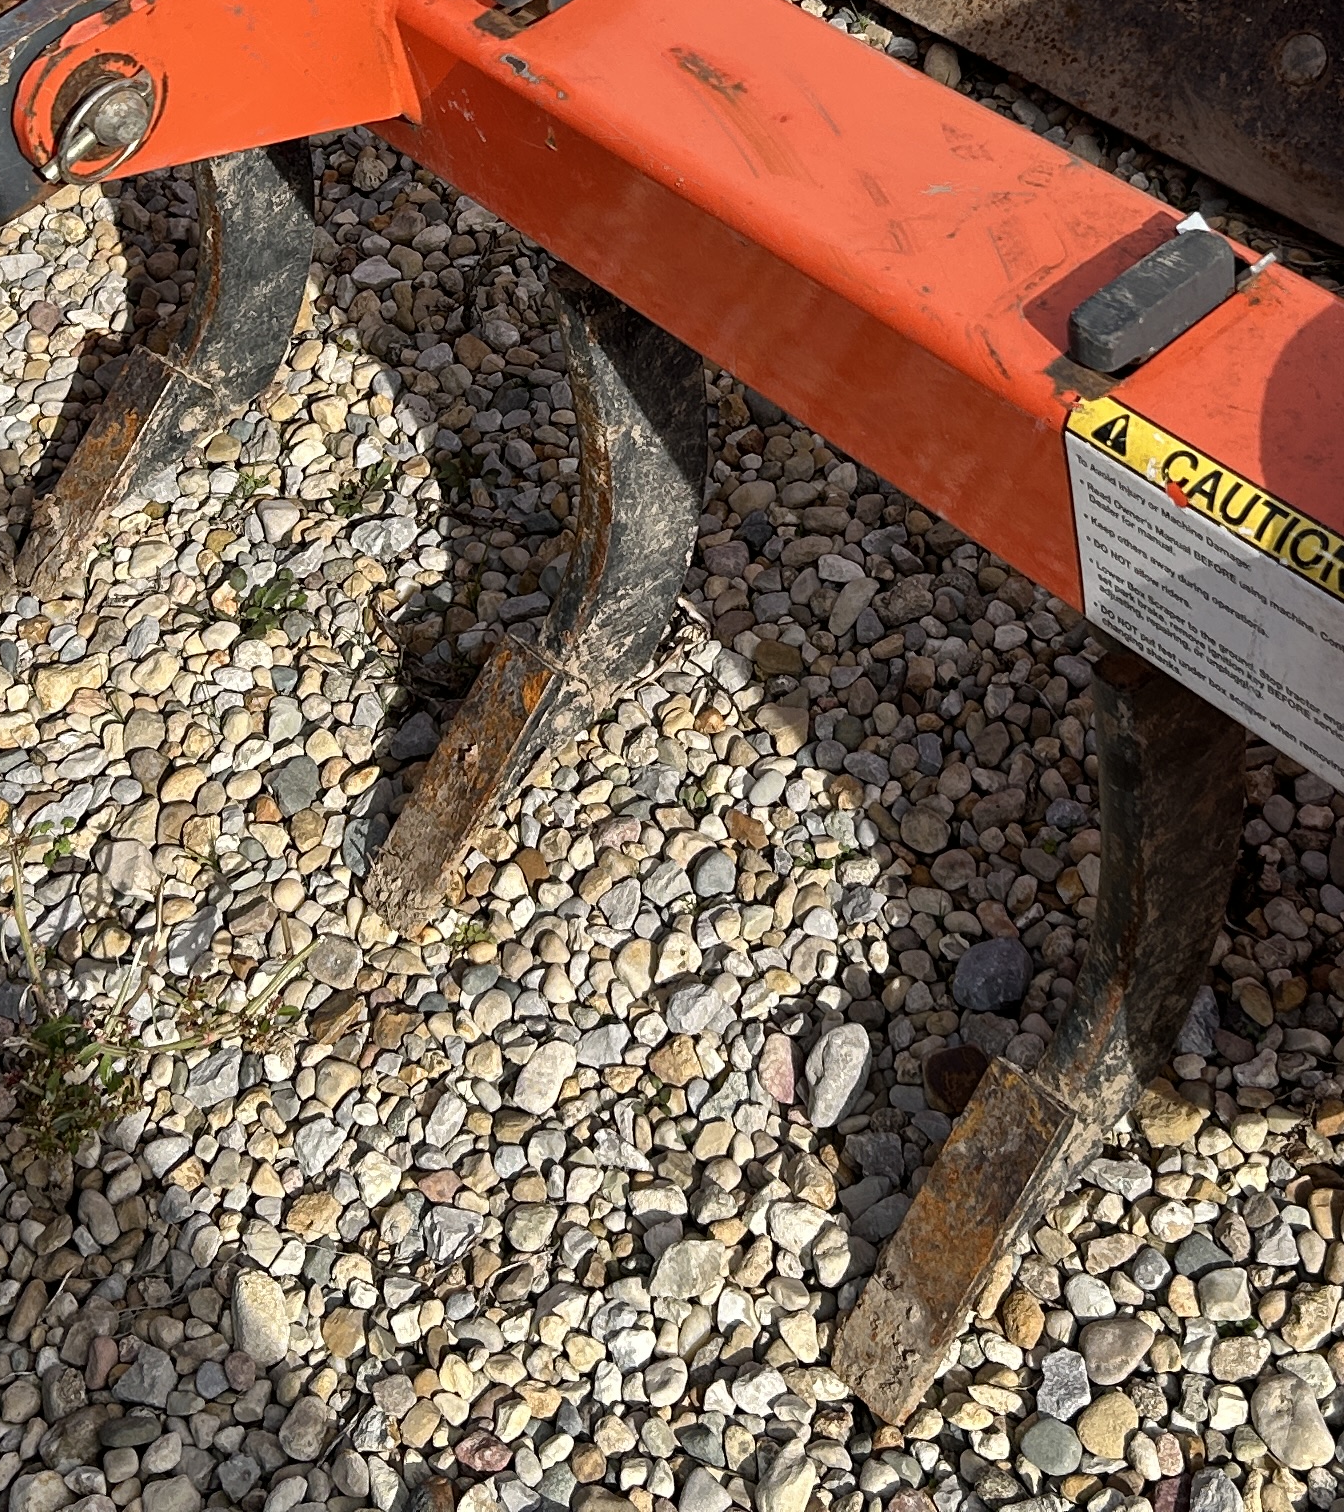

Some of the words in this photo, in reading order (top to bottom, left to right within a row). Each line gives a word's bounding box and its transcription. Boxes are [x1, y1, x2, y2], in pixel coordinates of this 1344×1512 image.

[1086, 481, 1112, 505] Read
[1154, 524, 1192, 556] Manual
[1193, 549, 1238, 585] BEFORE
[1238, 580, 1268, 606] using
[1090, 515, 1116, 539] Keep
[1116, 535, 1149, 560] others
[1149, 556, 1176, 579] away
[1177, 573, 1210, 602] during
[1109, 548, 1132, 570] NOT
[1160, 507, 1204, 542] Machine
[1095, 559, 1126, 585] Lower
[1126, 580, 1146, 601] Box
[1147, 594, 1186, 626] Scraper
[1199, 629, 1217, 647] the
[1258, 668, 1284, 691] Stop
[1285, 685, 1322, 715] tractor
[1097, 573, 1113, 589] set
[1113, 584, 1136, 604] park
[1266, 683, 1312, 721] BEFORE
[1116, 615, 1139, 636] NOT
